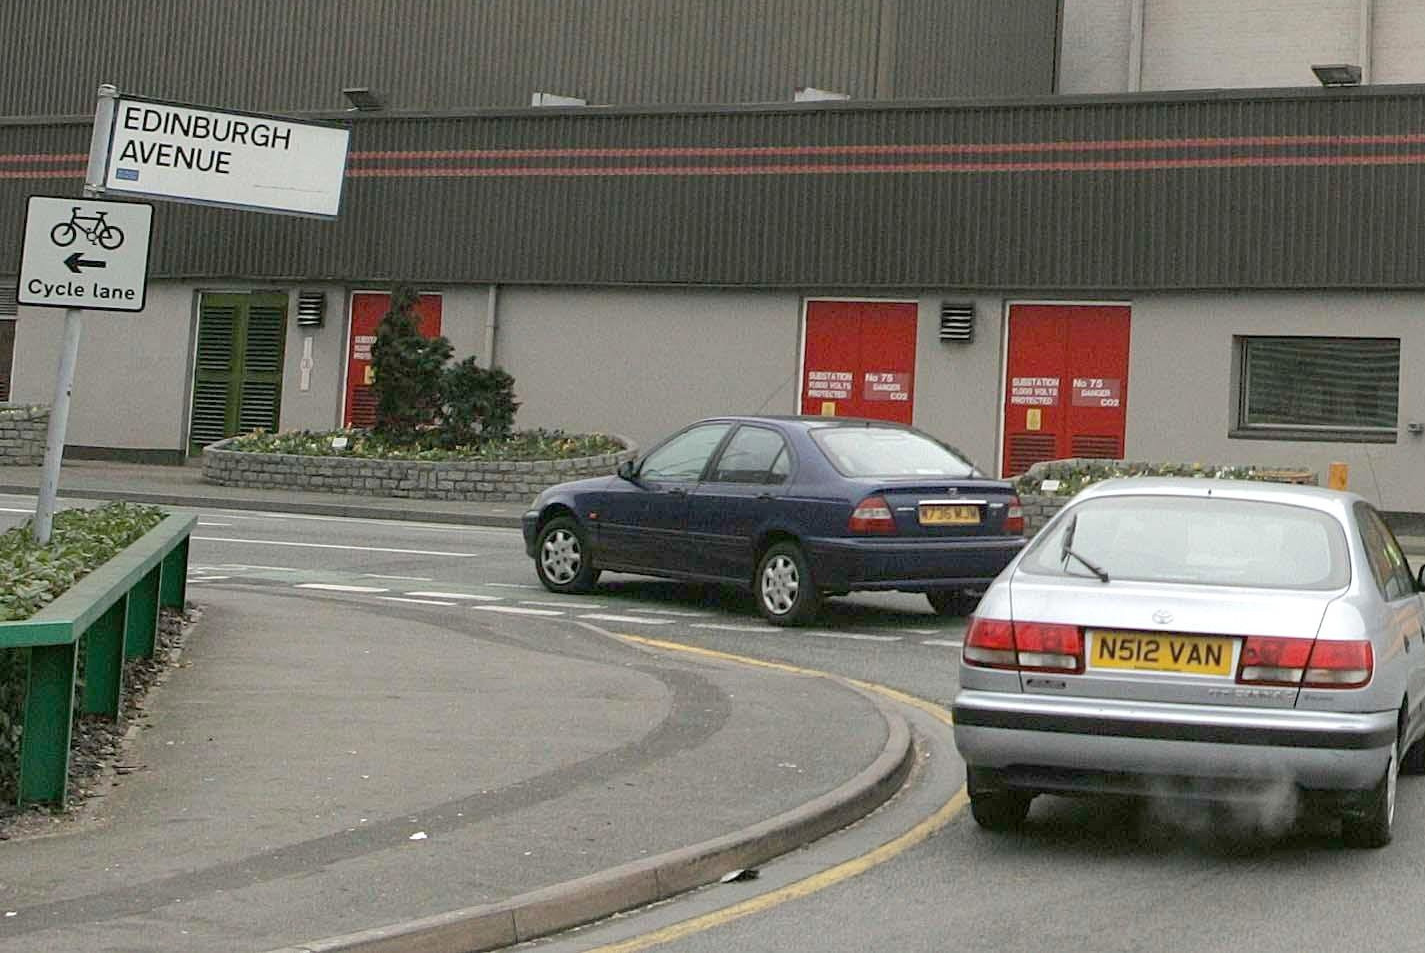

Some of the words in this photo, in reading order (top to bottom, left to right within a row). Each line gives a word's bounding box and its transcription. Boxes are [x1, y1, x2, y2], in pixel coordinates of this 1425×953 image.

[124, 107, 291, 150] EDINBURGH
[119, 139, 233, 174] AVENUE
[28, 279, 85, 300] Cycle
[93, 280, 136, 300] lane
[808, 371, 853, 381] SUBSTATION
[865, 373, 878, 382] No
[881, 373, 894, 382] 75
[830, 382, 852, 390] VOLTS
[1012, 377, 1060, 386] SUBSTATION
[1073, 378, 1087, 387] No
[1089, 379, 1103, 388] 75
[872, 383, 901, 391] DANGER
[808, 389, 847, 398] PROTECTED
[890, 392, 908, 400] CO2
[1034, 388, 1058, 396] VOLTS
[1081, 389, 1111, 397] DANGER
[1011, 396, 1053, 405] PROTECTED
[1100, 398, 1120, 407] CO2
[1099, 636, 1160, 663] N512
[1169, 641, 1223, 666] VAN
